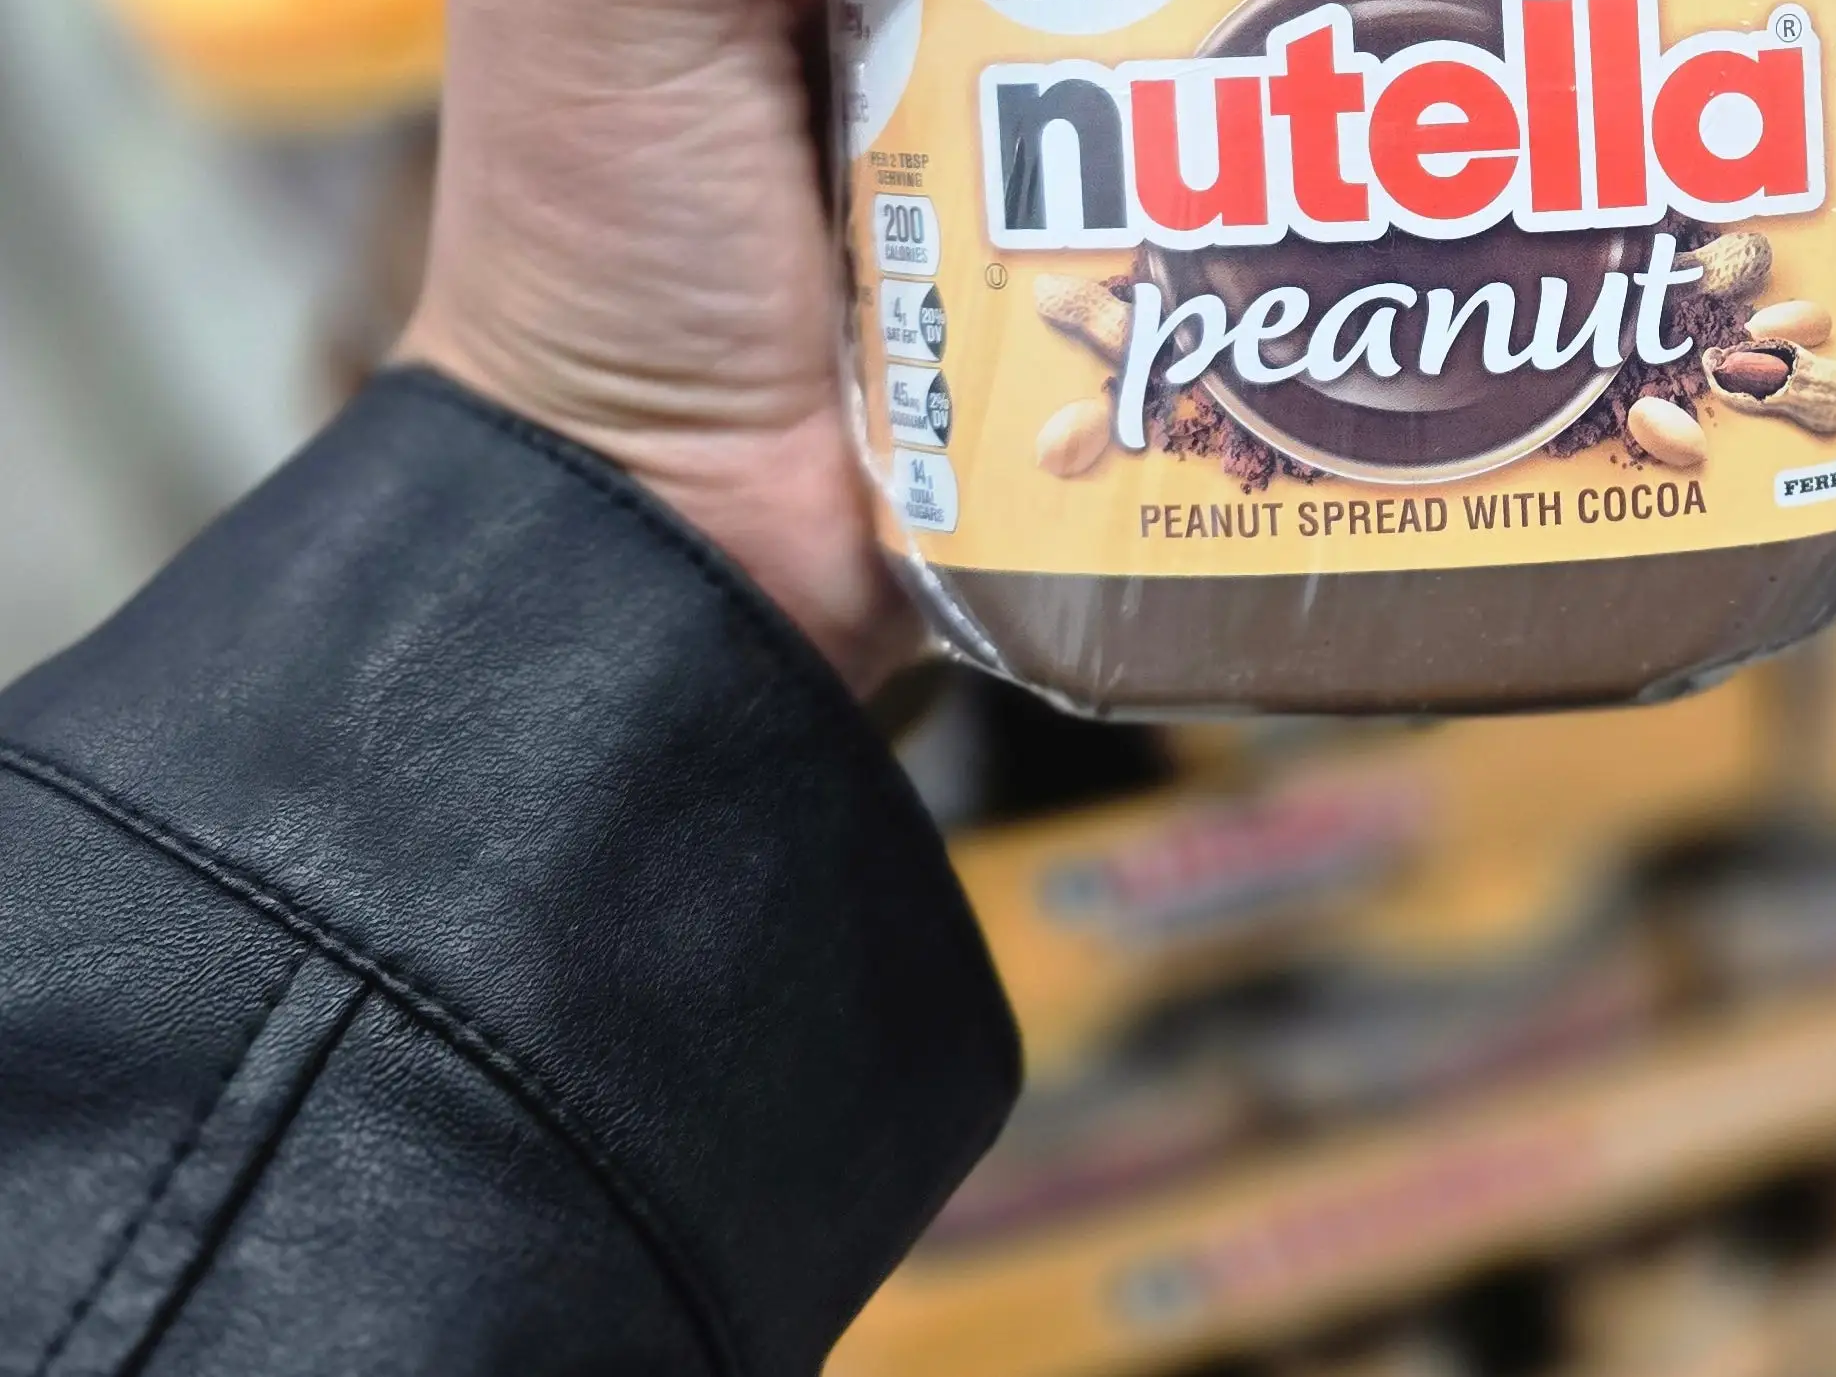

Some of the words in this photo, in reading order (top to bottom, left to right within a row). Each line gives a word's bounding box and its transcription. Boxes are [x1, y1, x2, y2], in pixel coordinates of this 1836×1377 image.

[884, 204, 925, 244] 200
[1115, 232, 1704, 451] peanut
[1140, 502, 1283, 539] PEANUT
[1297, 497, 1448, 536] SPREAD
[1462, 491, 1562, 530] WITH
[1577, 480, 1707, 524] COCOA
